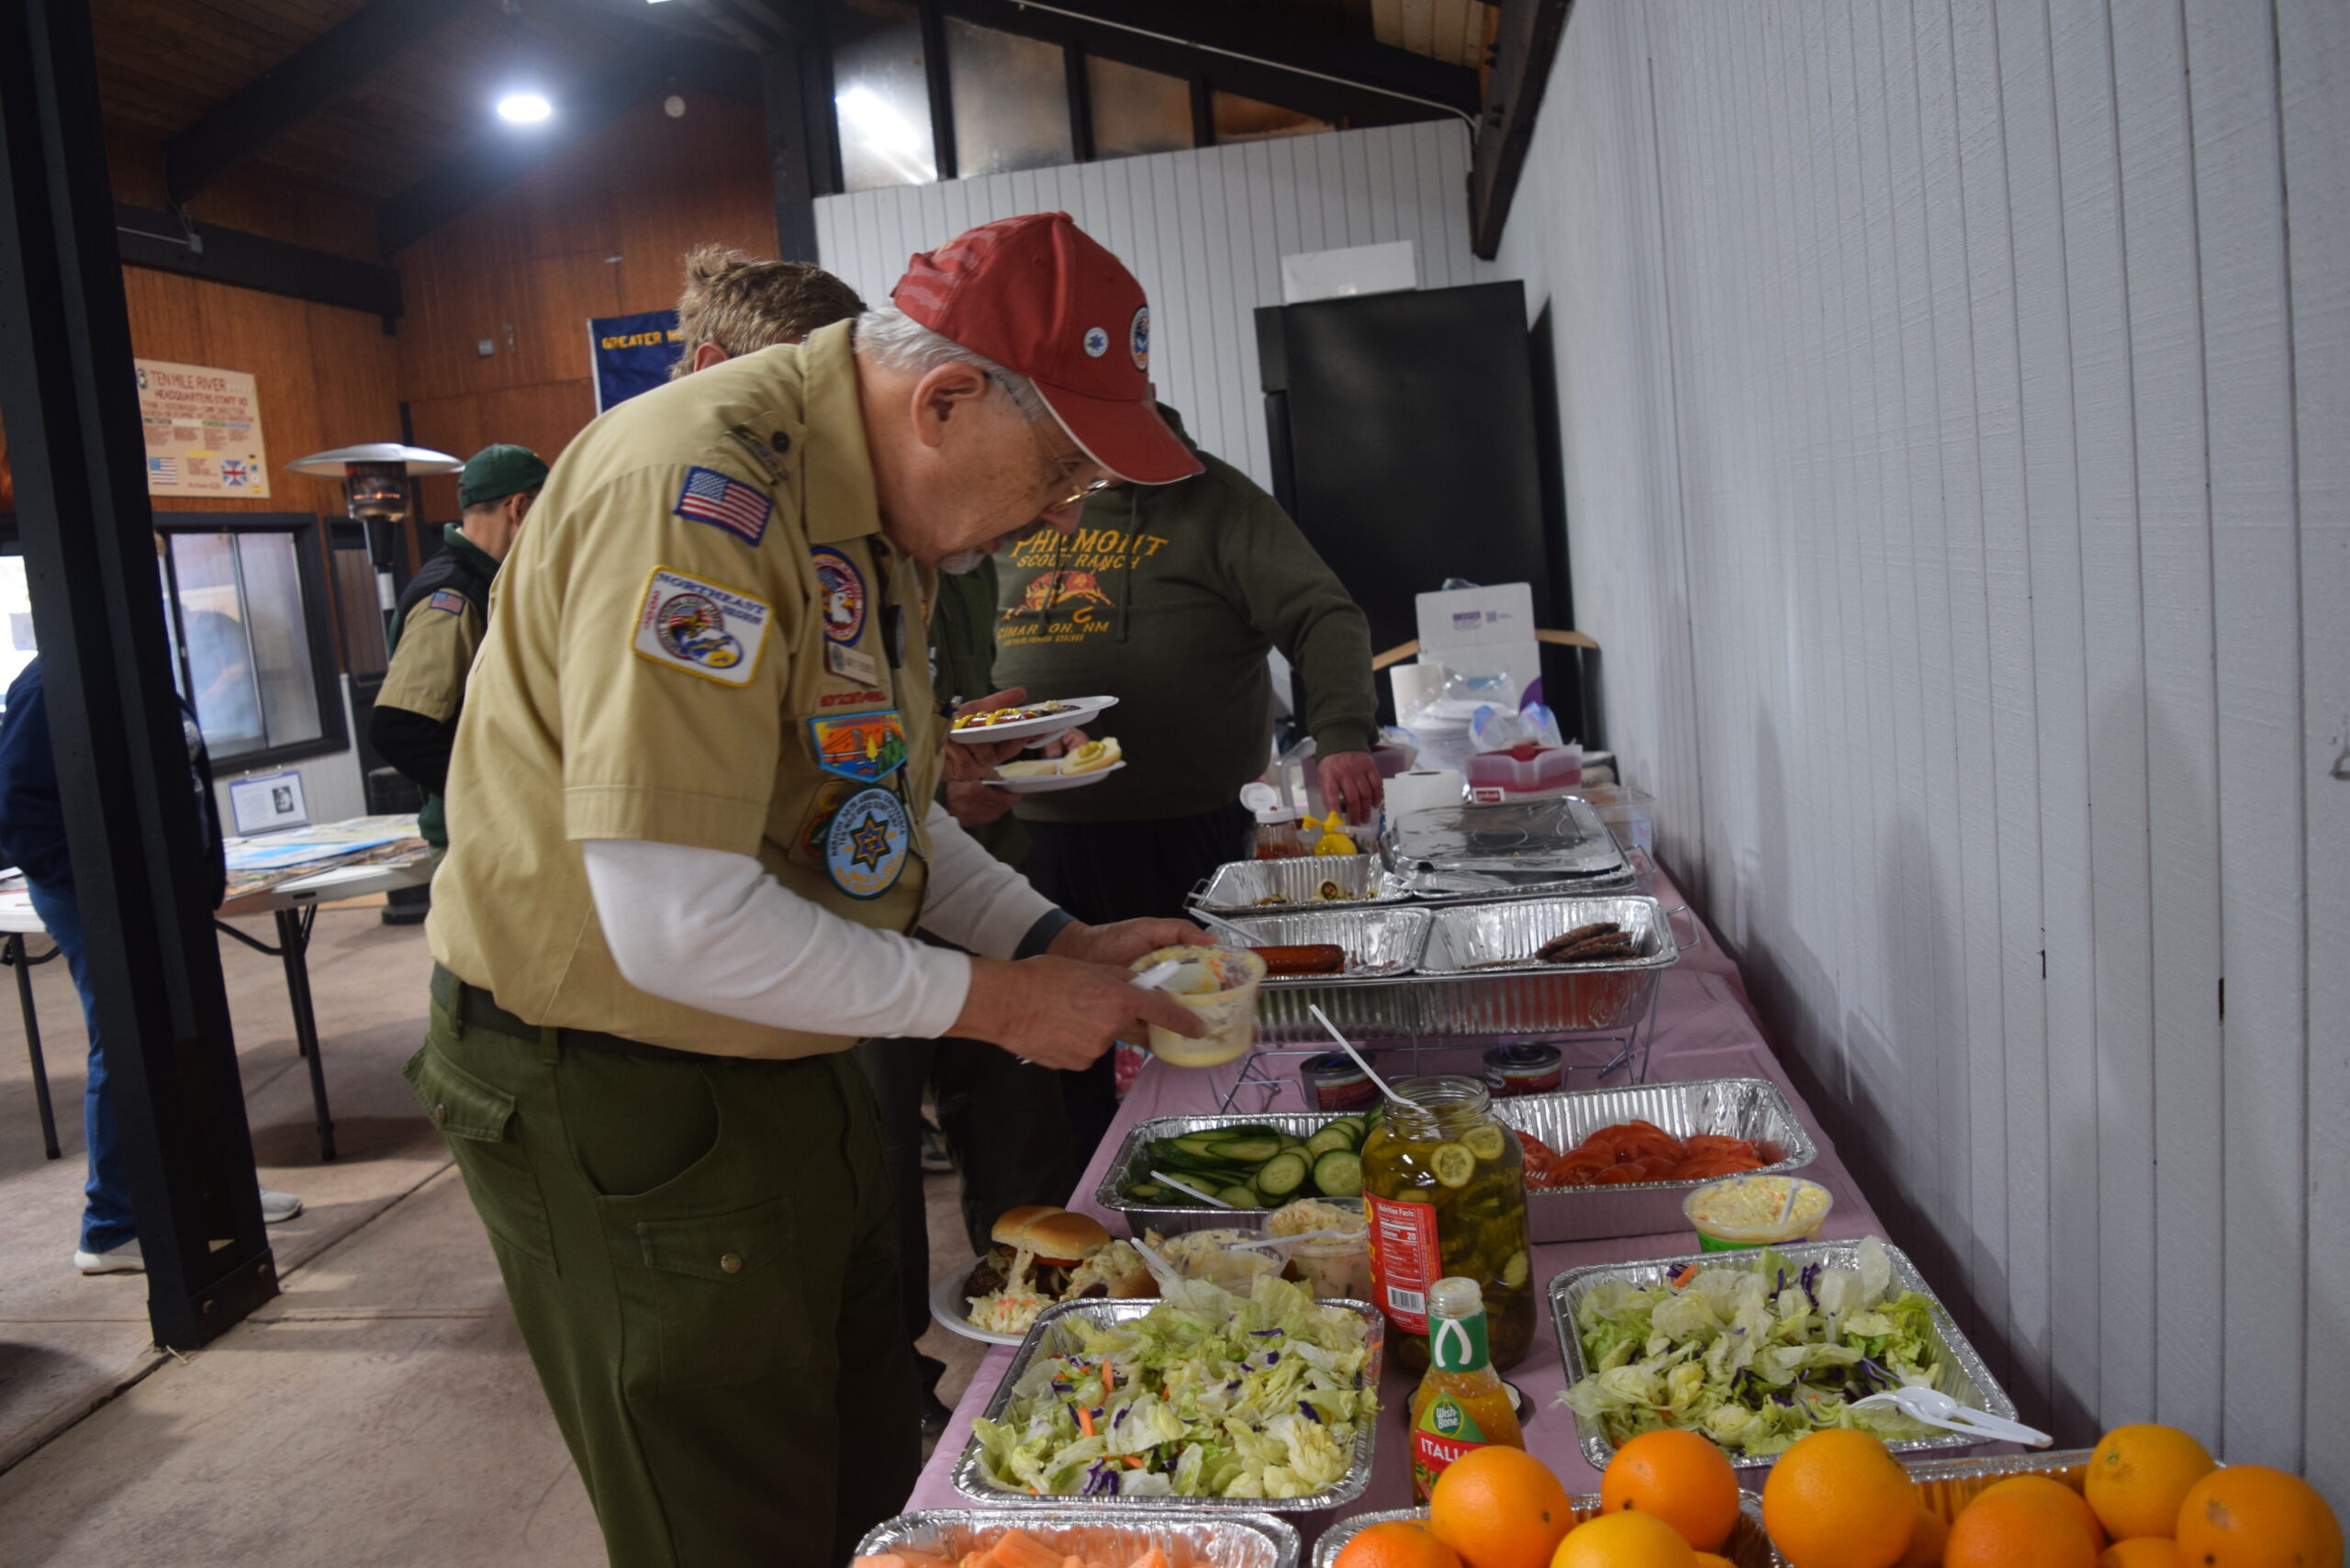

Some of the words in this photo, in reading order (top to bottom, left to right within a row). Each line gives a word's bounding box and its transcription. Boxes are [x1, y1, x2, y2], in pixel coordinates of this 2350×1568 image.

[601, 331, 661, 349] GREATER
[150, 370, 170, 386] TEN
[171, 374, 195, 389] MILE
[196, 375, 225, 392] RIVER
[154, 388, 214, 404] HEADQUARTERS
[1017, 554, 1072, 568] SCOUT
[1074, 553, 1141, 569] RANCH
[1082, 621, 1110, 633] NM
[1379, 1204, 1398, 1215] Nutrition
[1398, 1208, 1415, 1217] Facts
[1406, 1232, 1416, 1240] 20
[1438, 1417, 1458, 1429] Bone
[1421, 1437, 1469, 1462] ITALI
